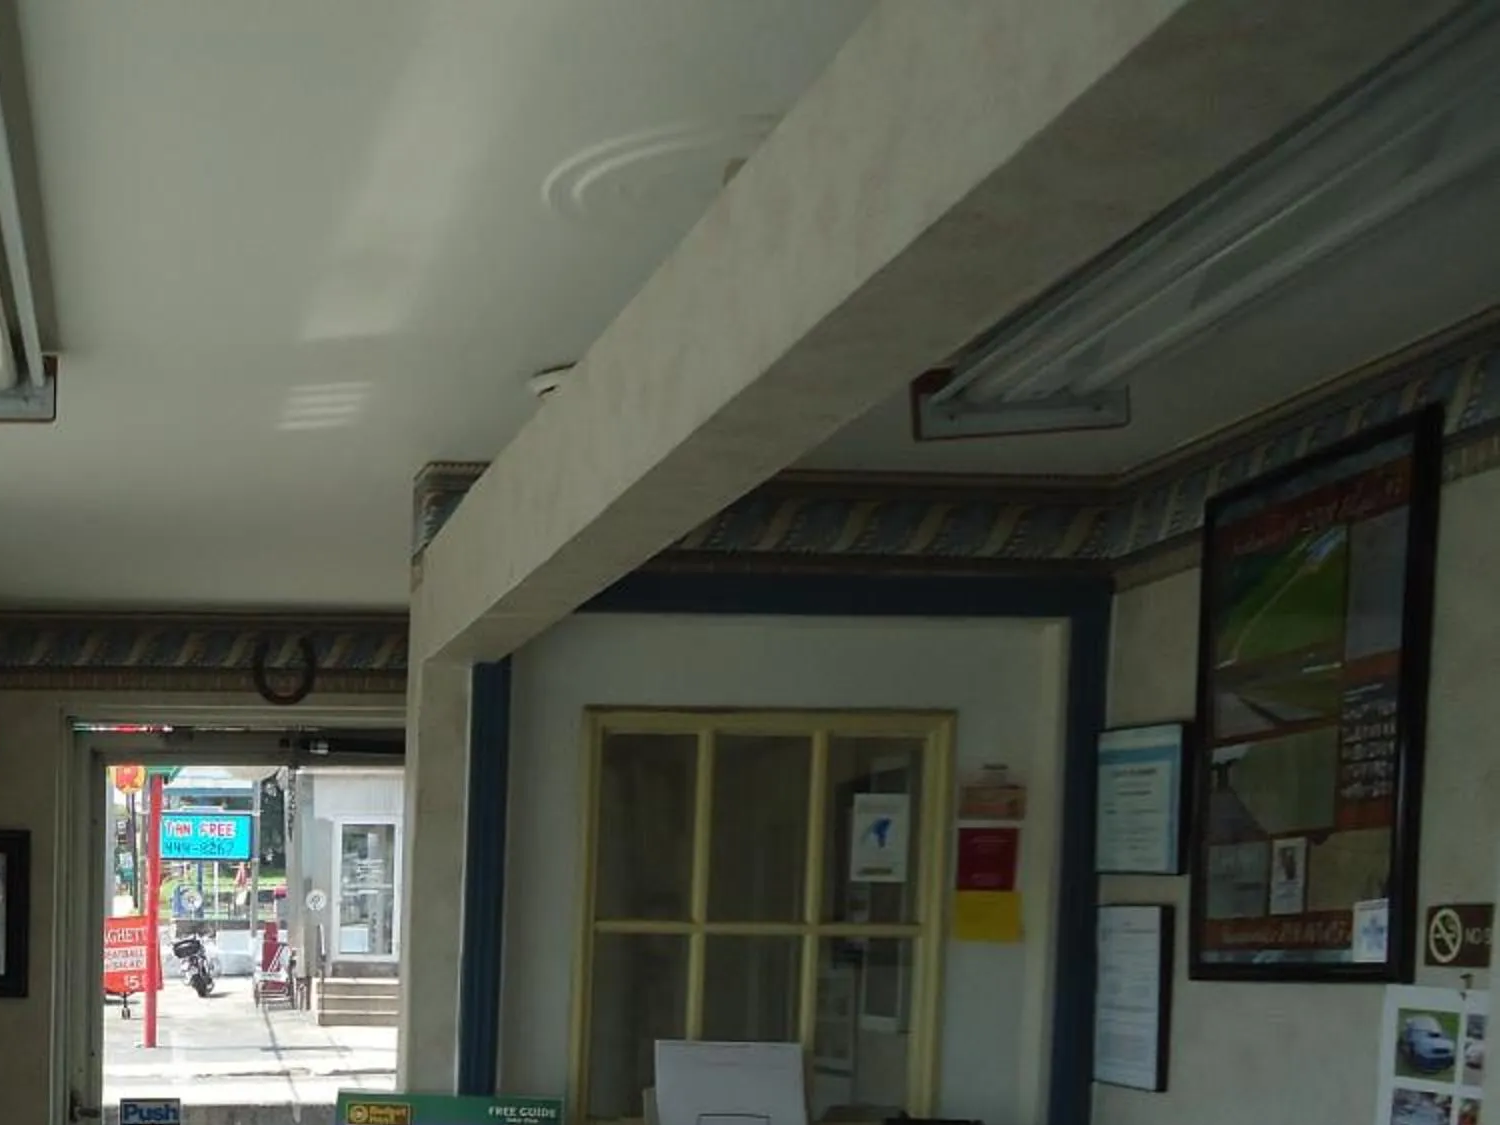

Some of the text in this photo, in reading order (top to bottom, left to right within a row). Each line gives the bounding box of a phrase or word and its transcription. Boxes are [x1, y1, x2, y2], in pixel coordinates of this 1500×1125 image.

[123, 1103, 177, 1121] Push
[488, 1105, 557, 1119] FREE GUIDE
